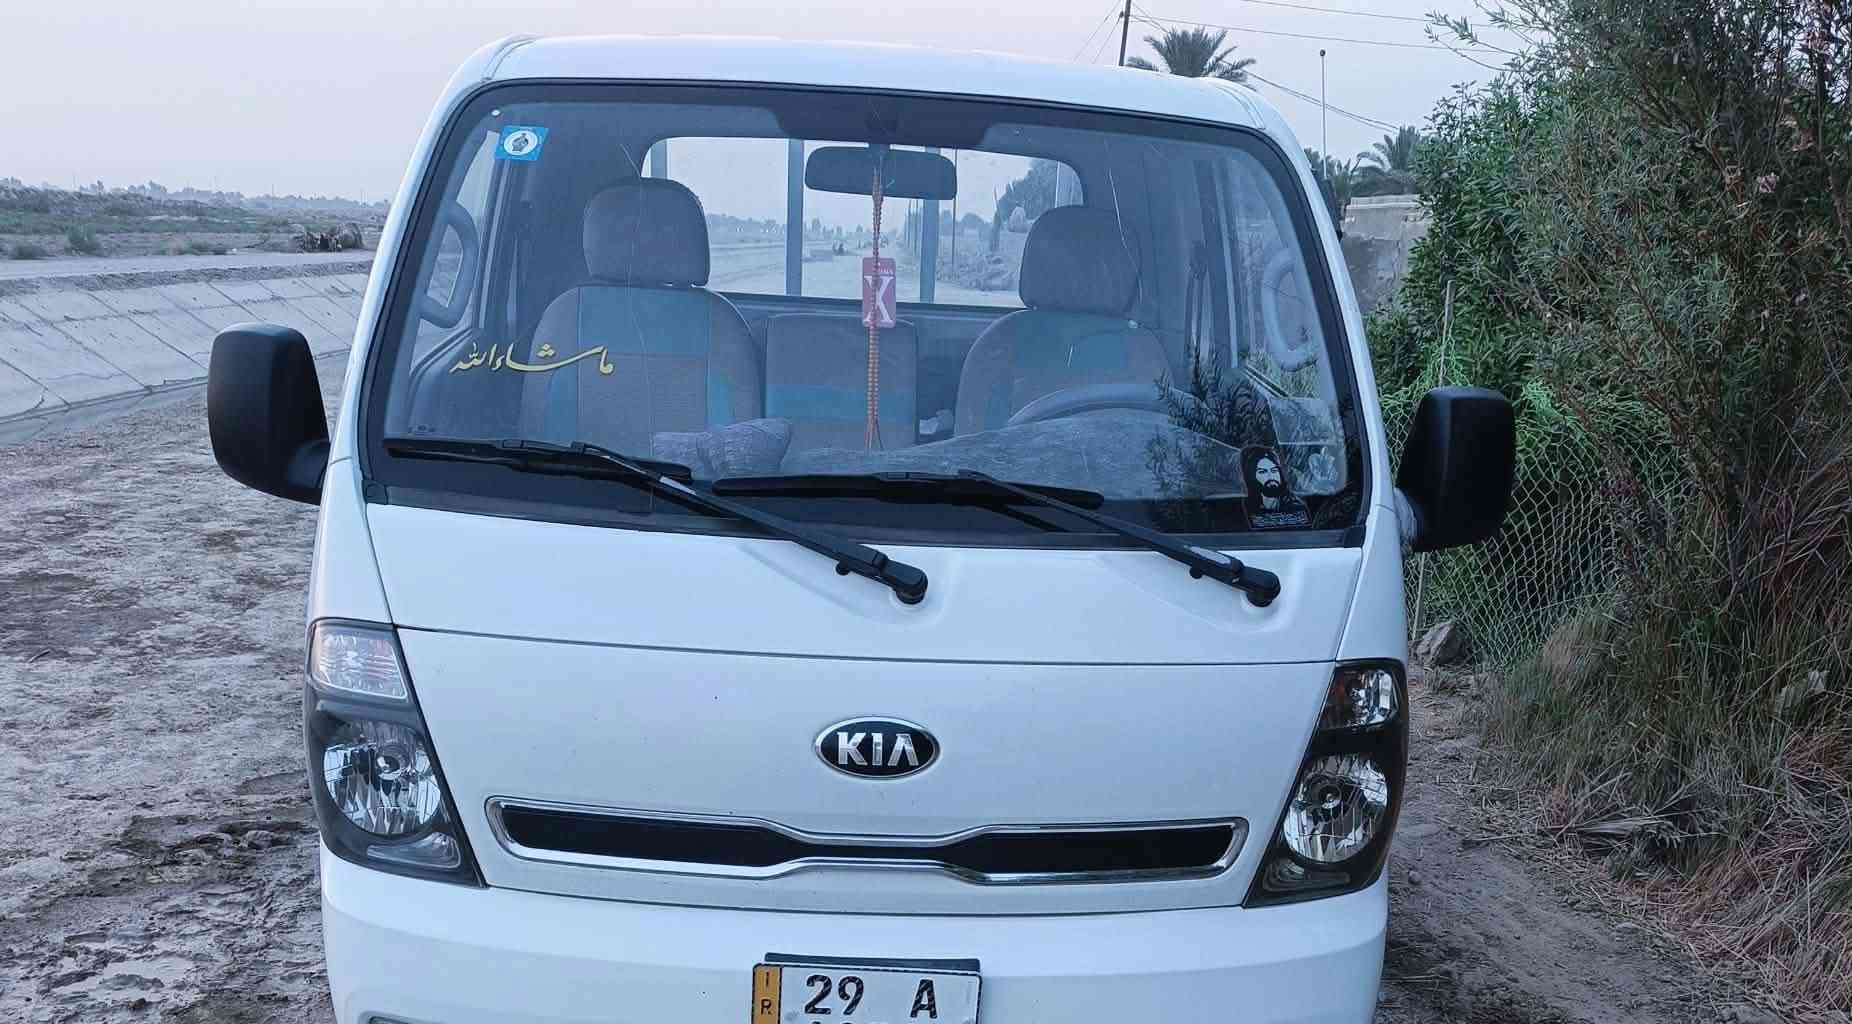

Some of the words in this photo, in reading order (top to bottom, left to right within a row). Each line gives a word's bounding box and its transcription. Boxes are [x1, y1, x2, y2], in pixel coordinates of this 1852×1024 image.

[836, 731, 919, 766] KIA
[803, 973, 865, 1016] 29
[909, 978, 939, 1019] A
